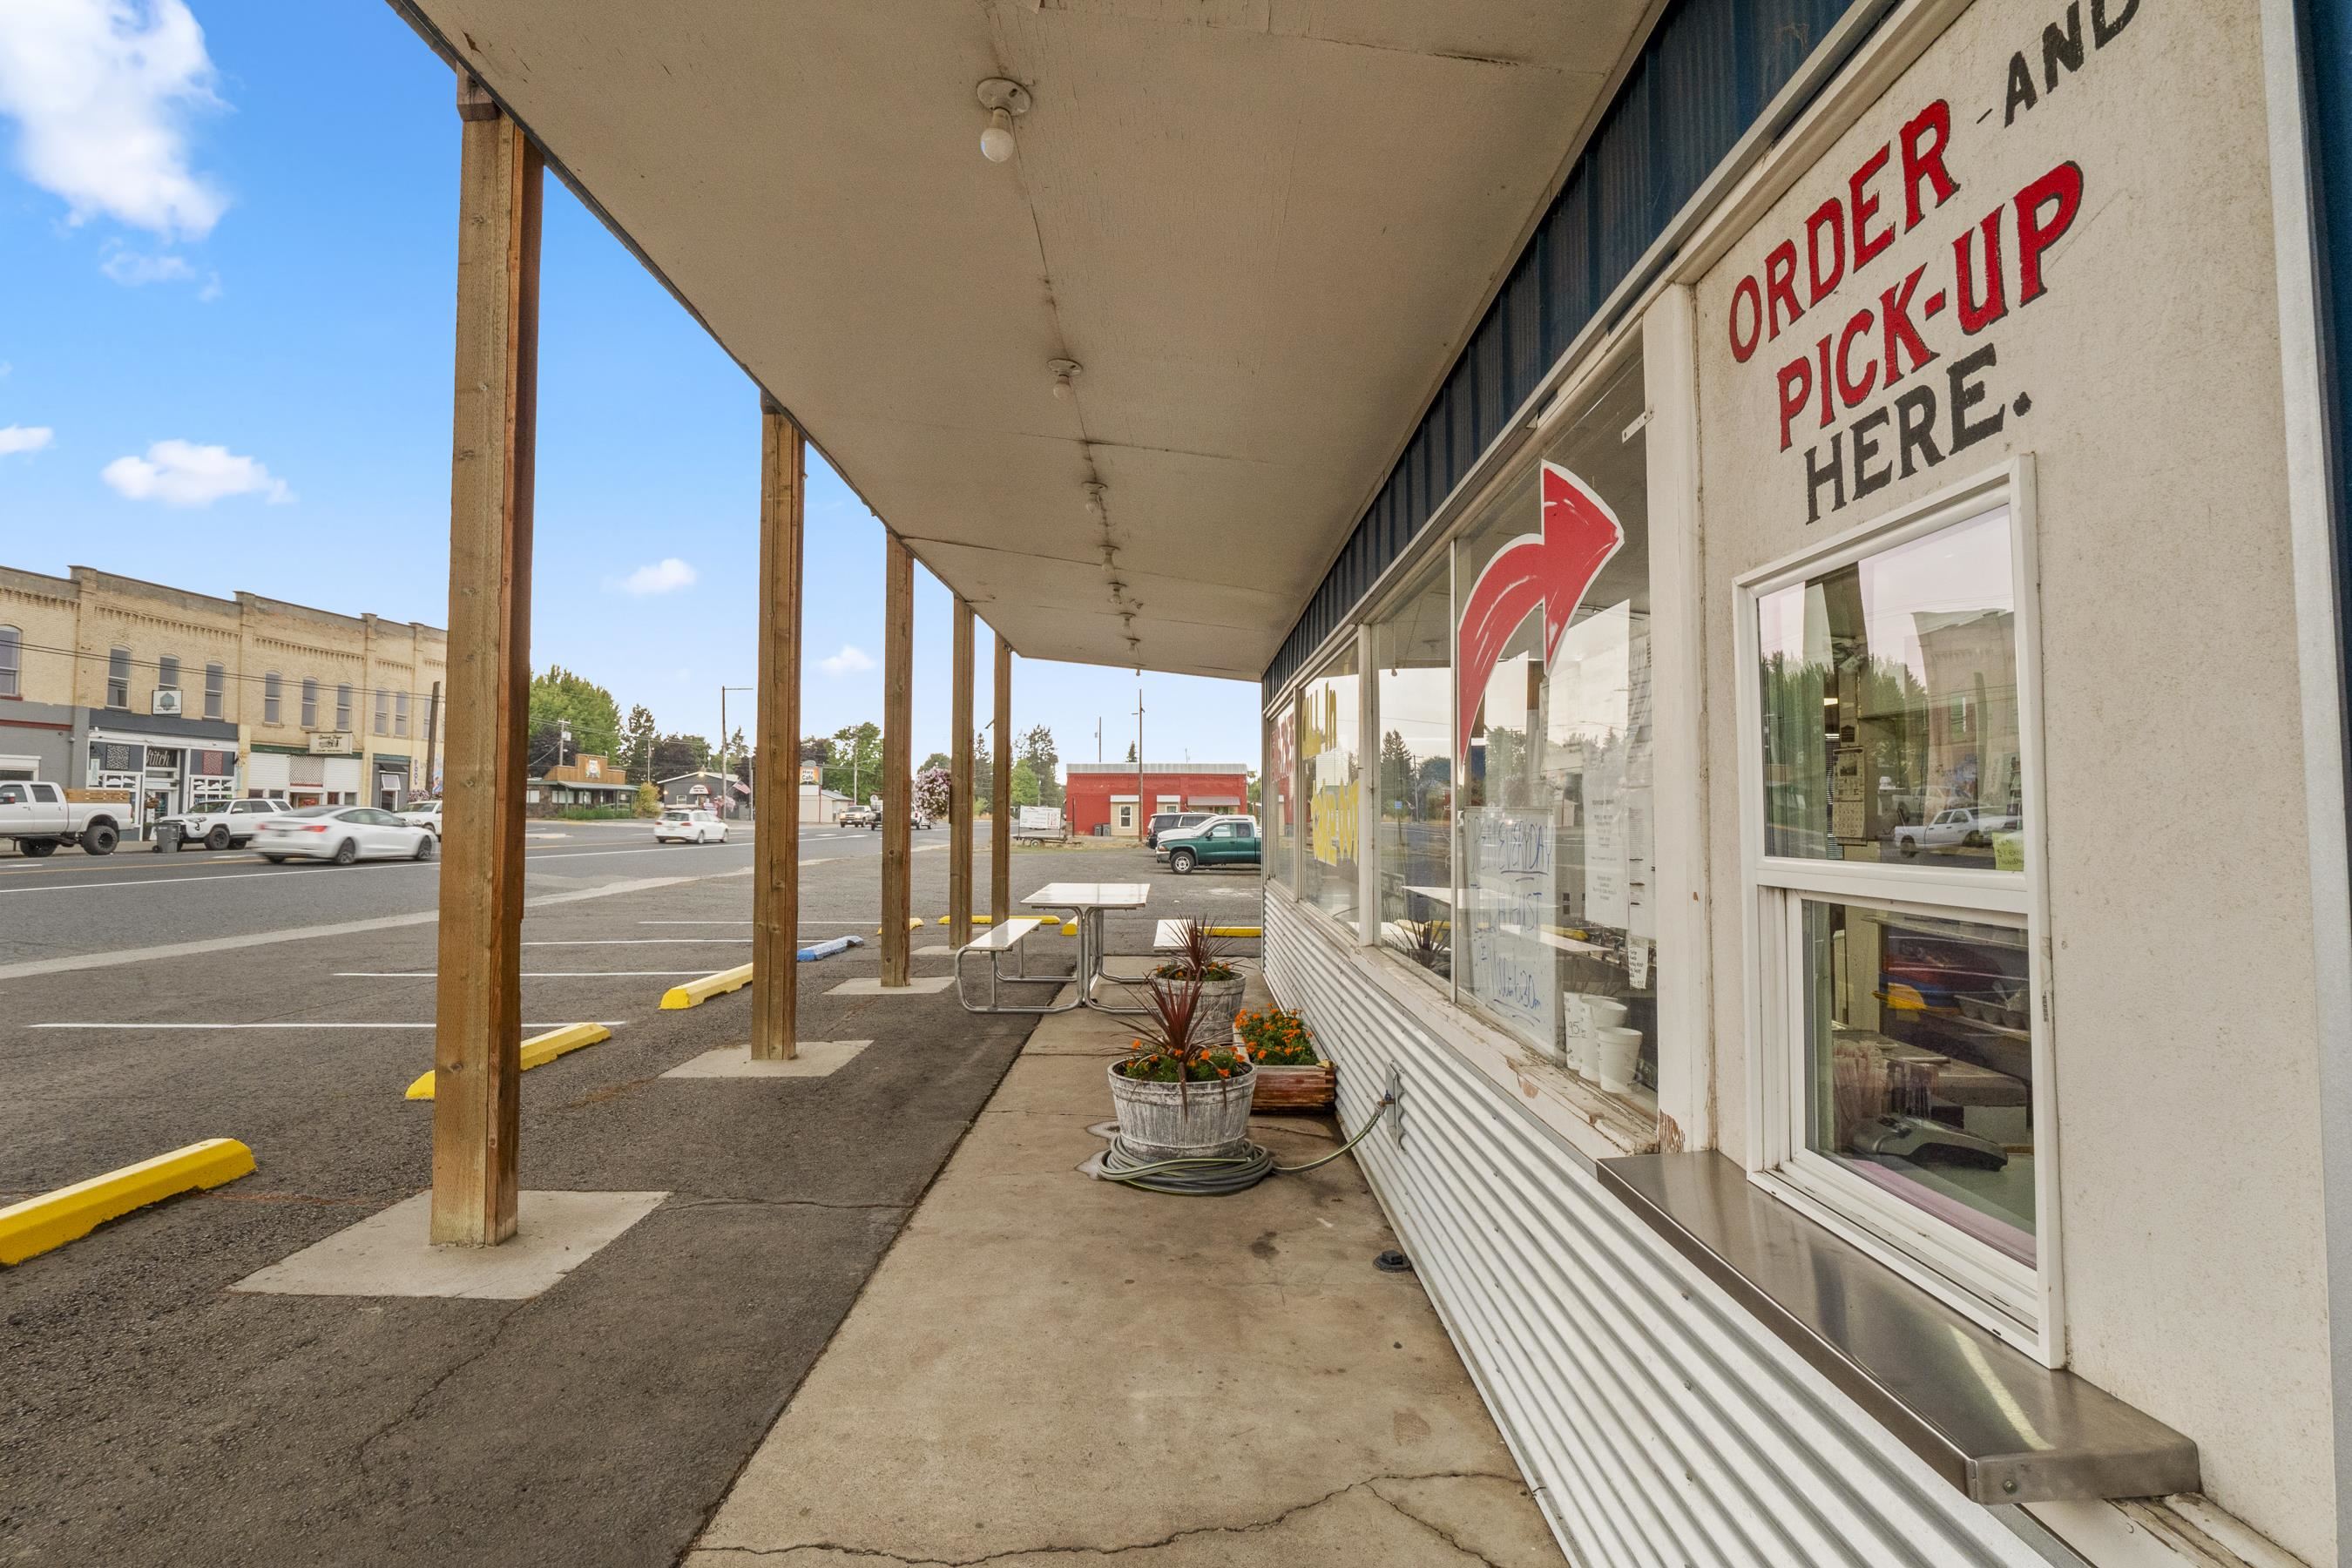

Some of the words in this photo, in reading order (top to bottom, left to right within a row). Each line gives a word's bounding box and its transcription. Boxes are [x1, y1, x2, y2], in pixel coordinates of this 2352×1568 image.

[1728, 98, 1961, 363] ORDER
[2004, 0, 2140, 128] AND
[1776, 160, 2084, 453] PICK-UP
[1805, 343, 2032, 524] HERE.
